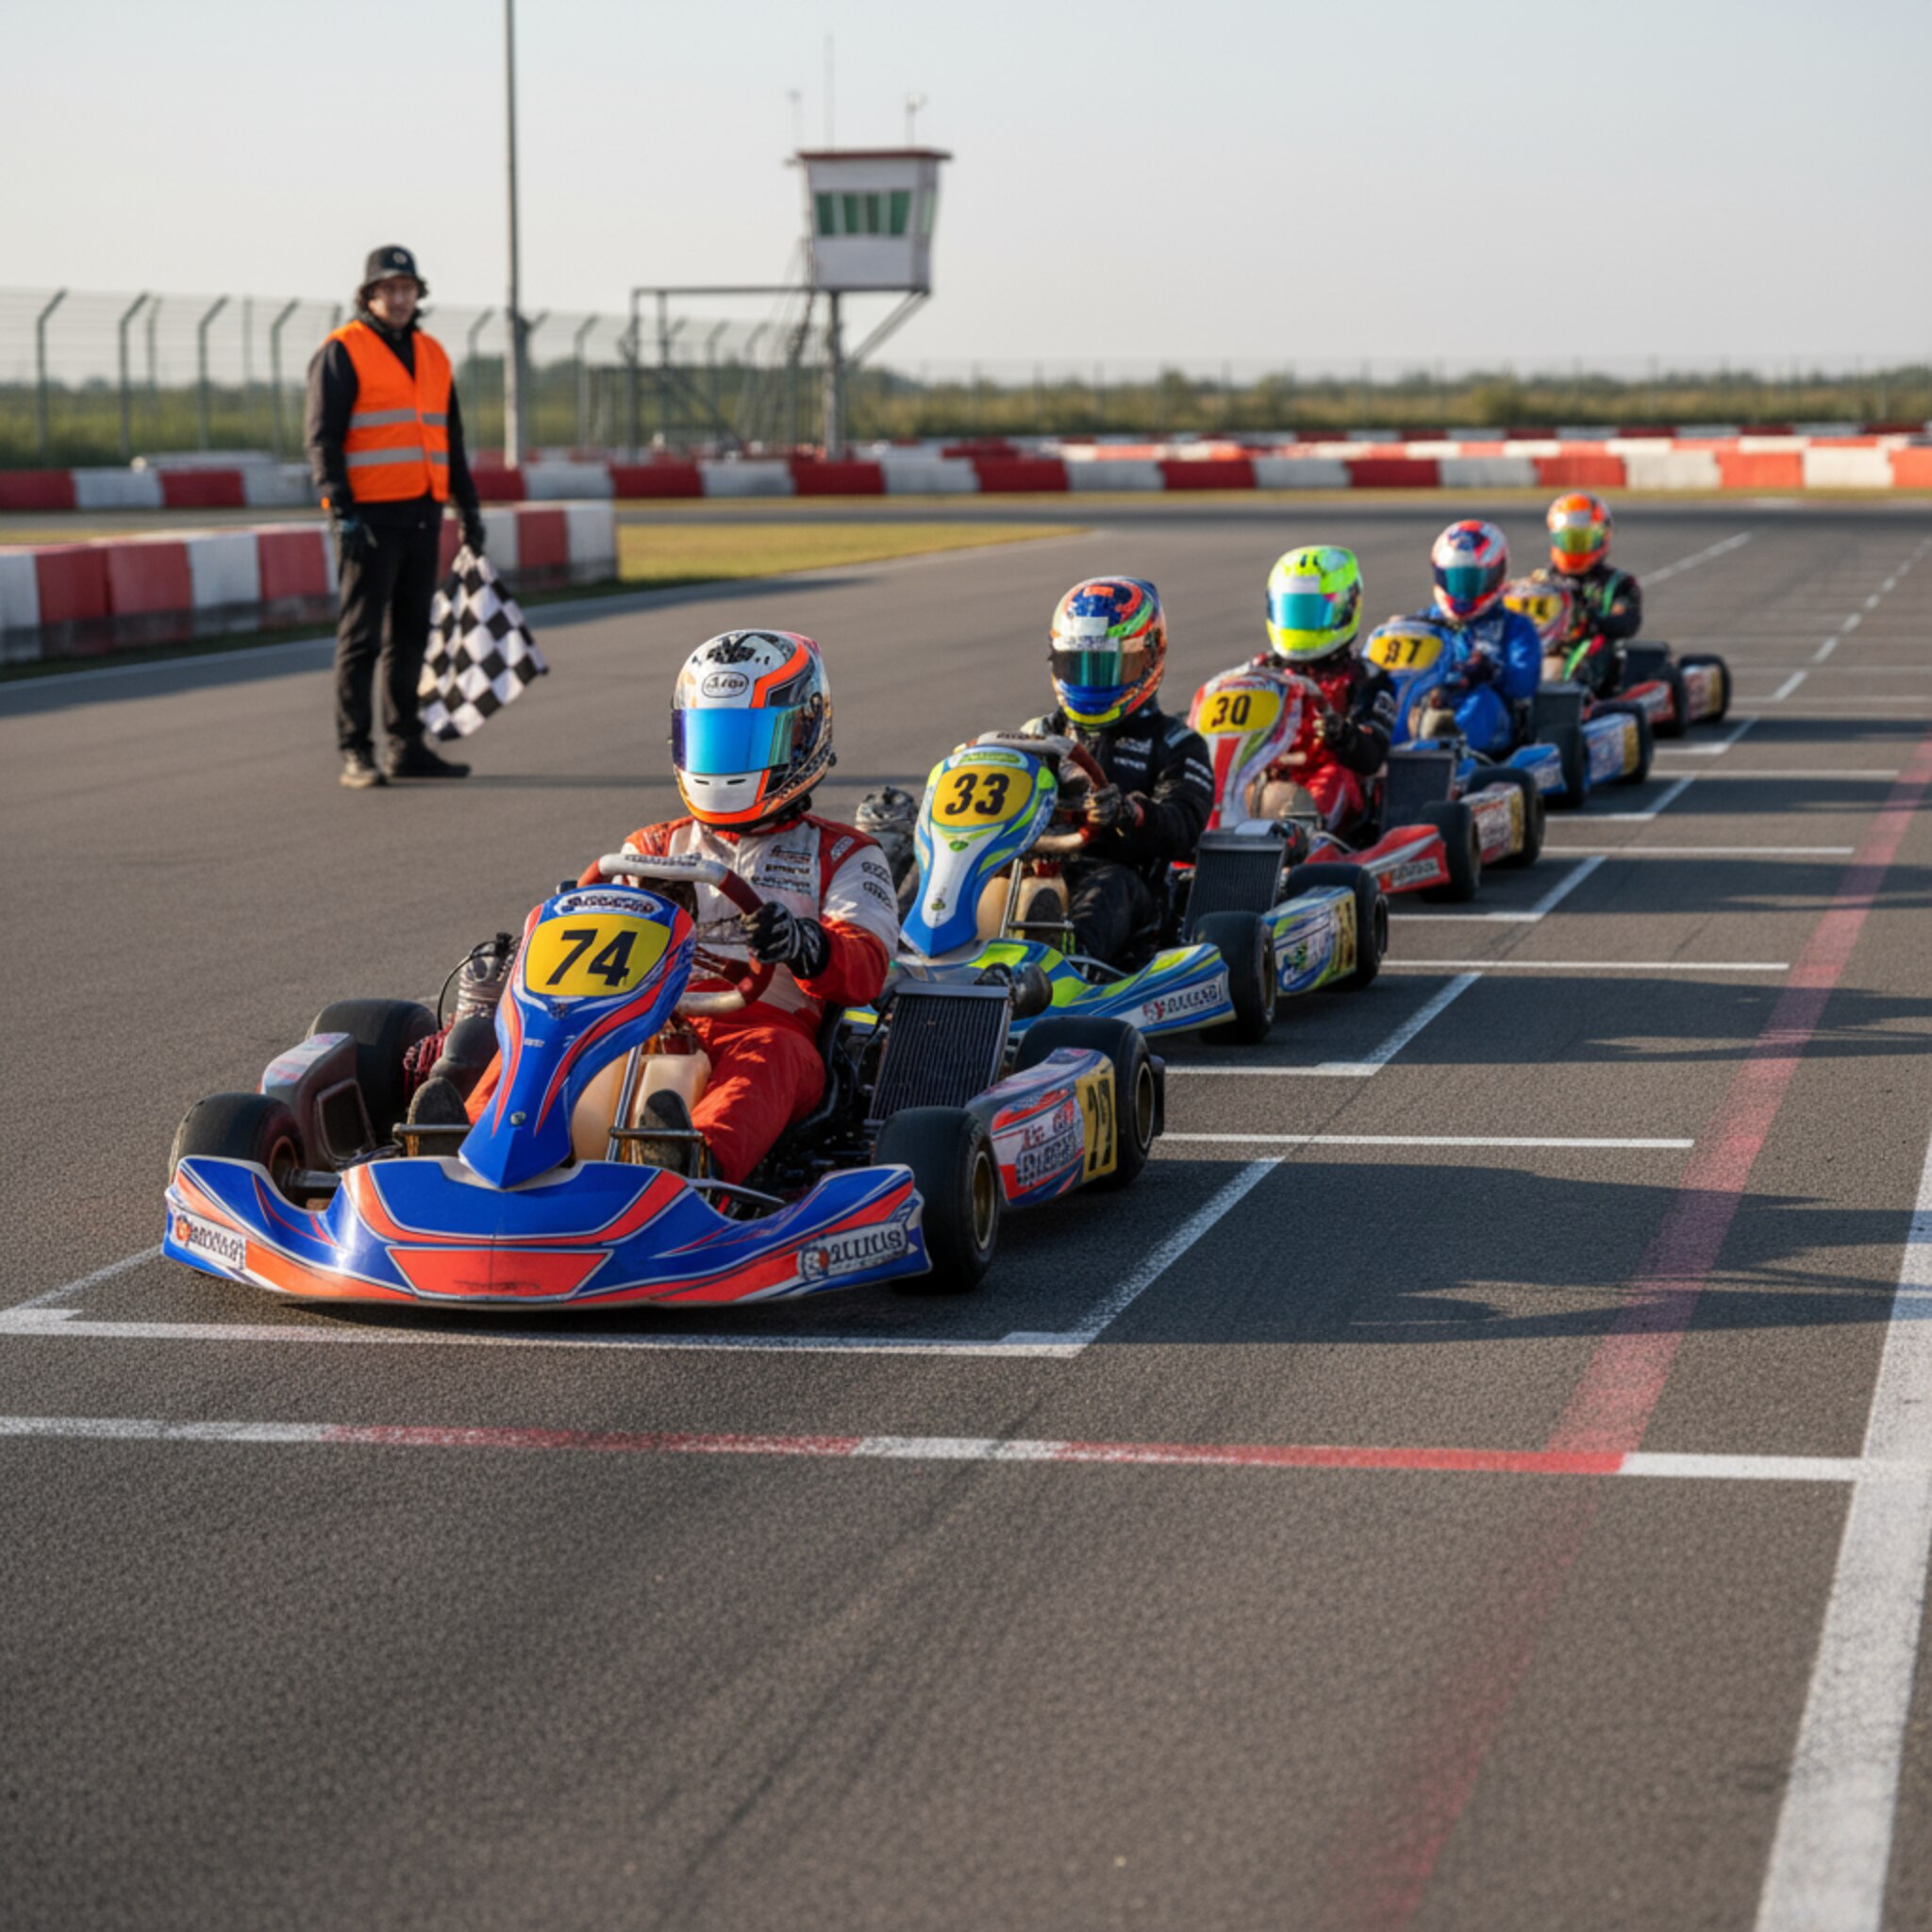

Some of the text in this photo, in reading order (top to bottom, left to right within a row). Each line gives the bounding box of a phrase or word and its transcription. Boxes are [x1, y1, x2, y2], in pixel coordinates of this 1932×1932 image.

[1211, 694, 1251, 727] 30
[944, 773, 1009, 816] 33
[545, 928, 638, 987] 74
